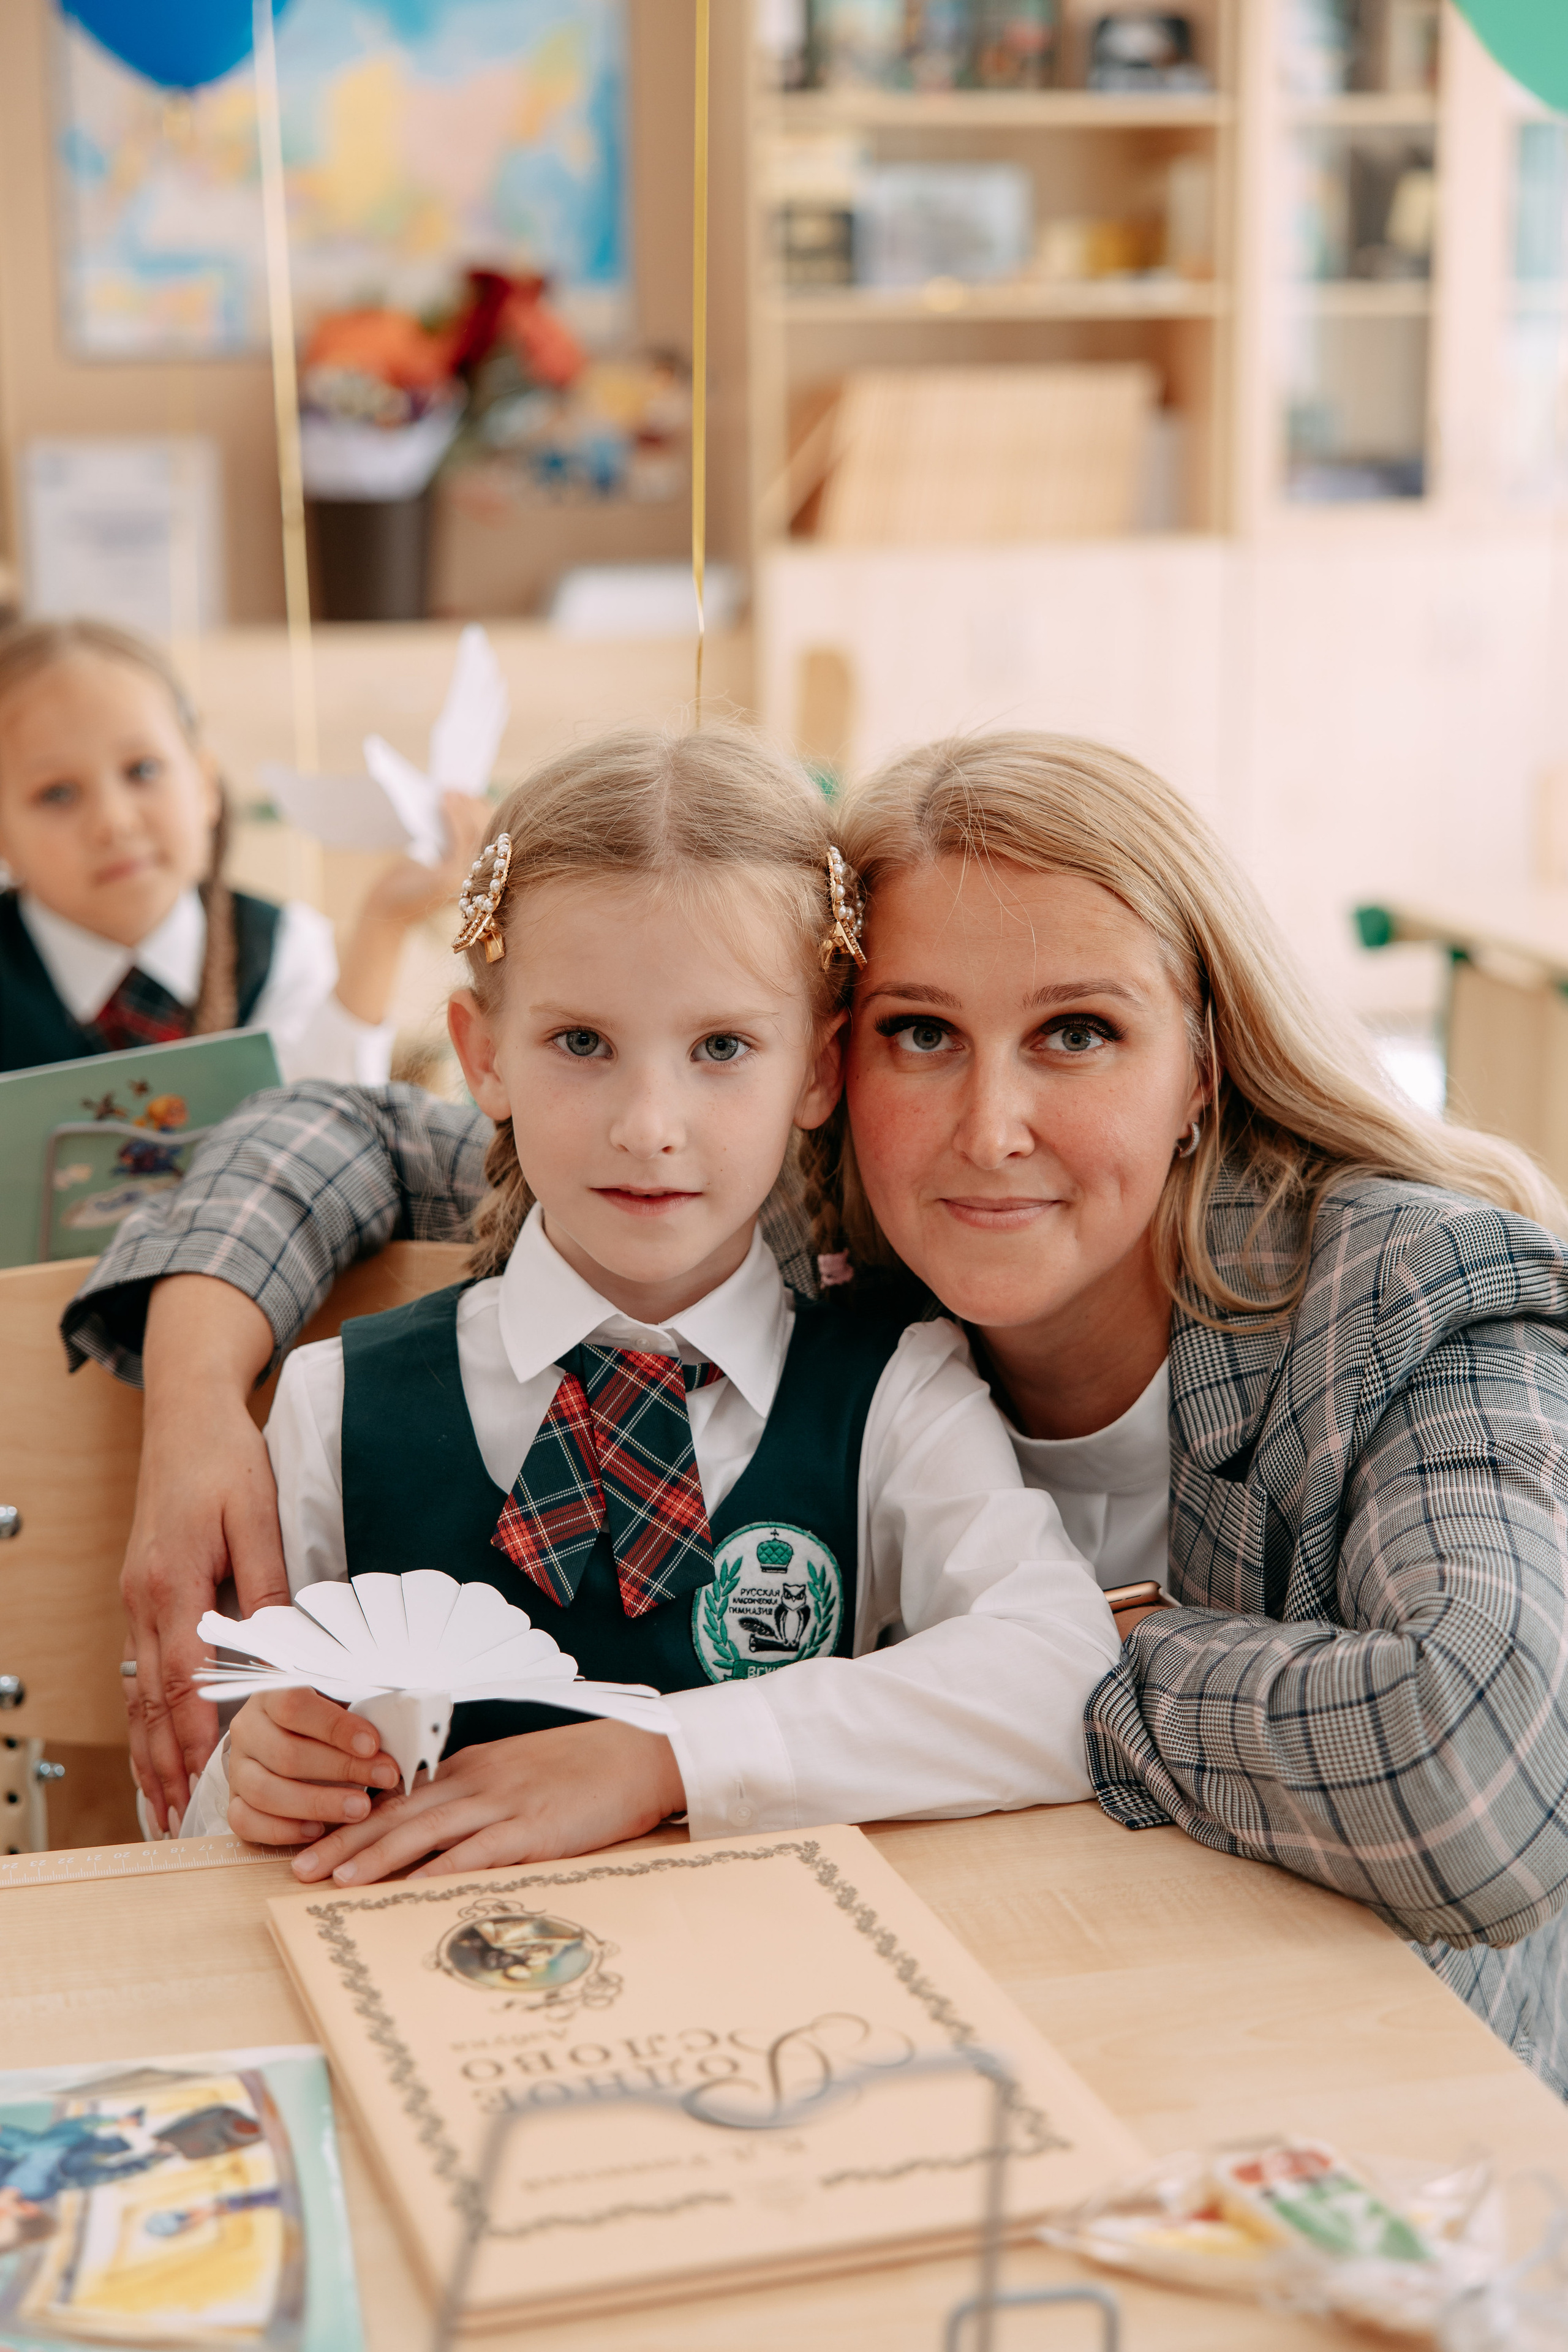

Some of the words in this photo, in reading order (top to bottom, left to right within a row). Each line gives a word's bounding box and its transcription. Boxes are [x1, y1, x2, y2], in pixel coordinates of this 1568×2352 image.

[740, 1588, 780, 1597] РУССКАЯ
[728, 1606, 773, 1615] ГИМНАЗИЯ
[461, 2027, 720, 2082] СЛОВО
